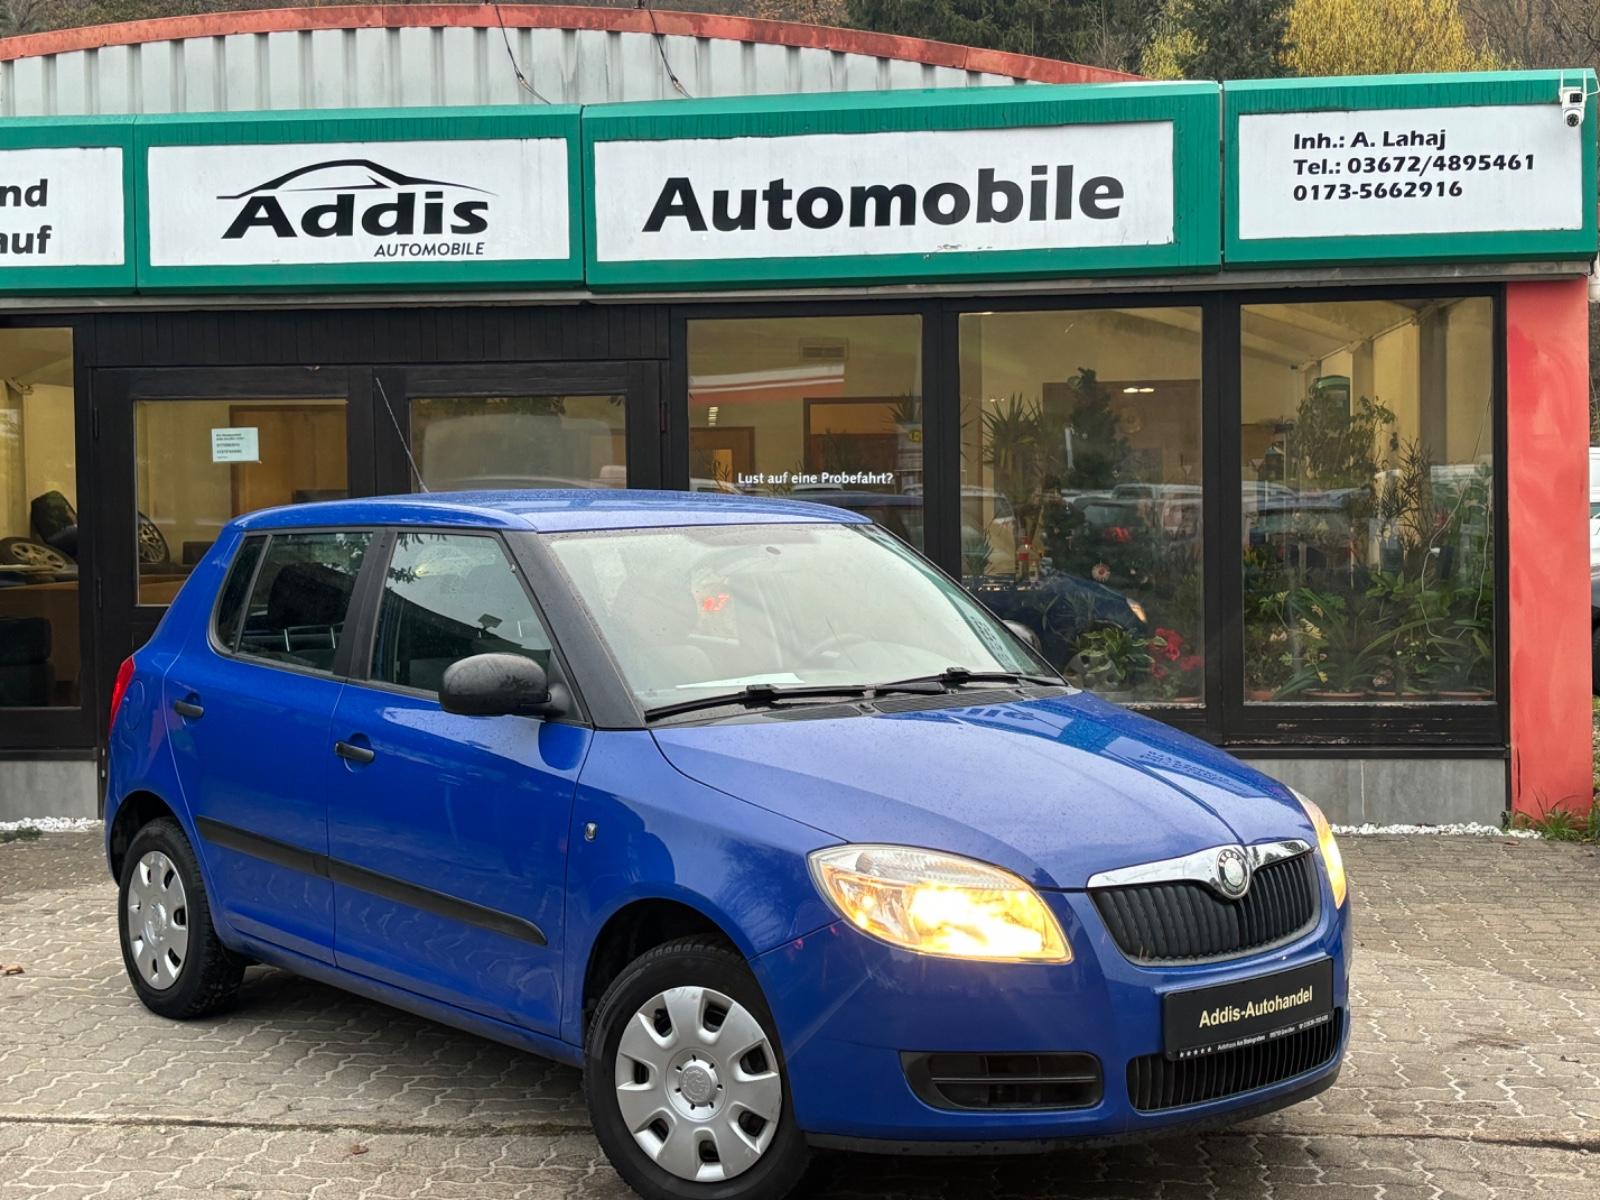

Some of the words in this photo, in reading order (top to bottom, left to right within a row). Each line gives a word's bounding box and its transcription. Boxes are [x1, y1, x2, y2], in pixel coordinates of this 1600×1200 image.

[1293, 133, 1345, 150] Inh.:
[1350, 131, 1376, 148] A.
[1382, 129, 1446, 151] Lahaj
[1293, 158, 1341, 176] Tel.:
[1347, 154, 1535, 177] 03672/4895461
[641, 164, 1125, 233] Automobile
[1293, 180, 1463, 202] 0173-5662916
[221, 191, 489, 239] Addis
[374, 242, 485, 257] AUTOMOBILE
[737, 472, 764, 484] Lust
[767, 472, 788, 484] auf
[791, 472, 818, 484] eine
[821, 471, 894, 484] Probefahrt?
[1199, 985, 1313, 1028] Addis-Autohandel
